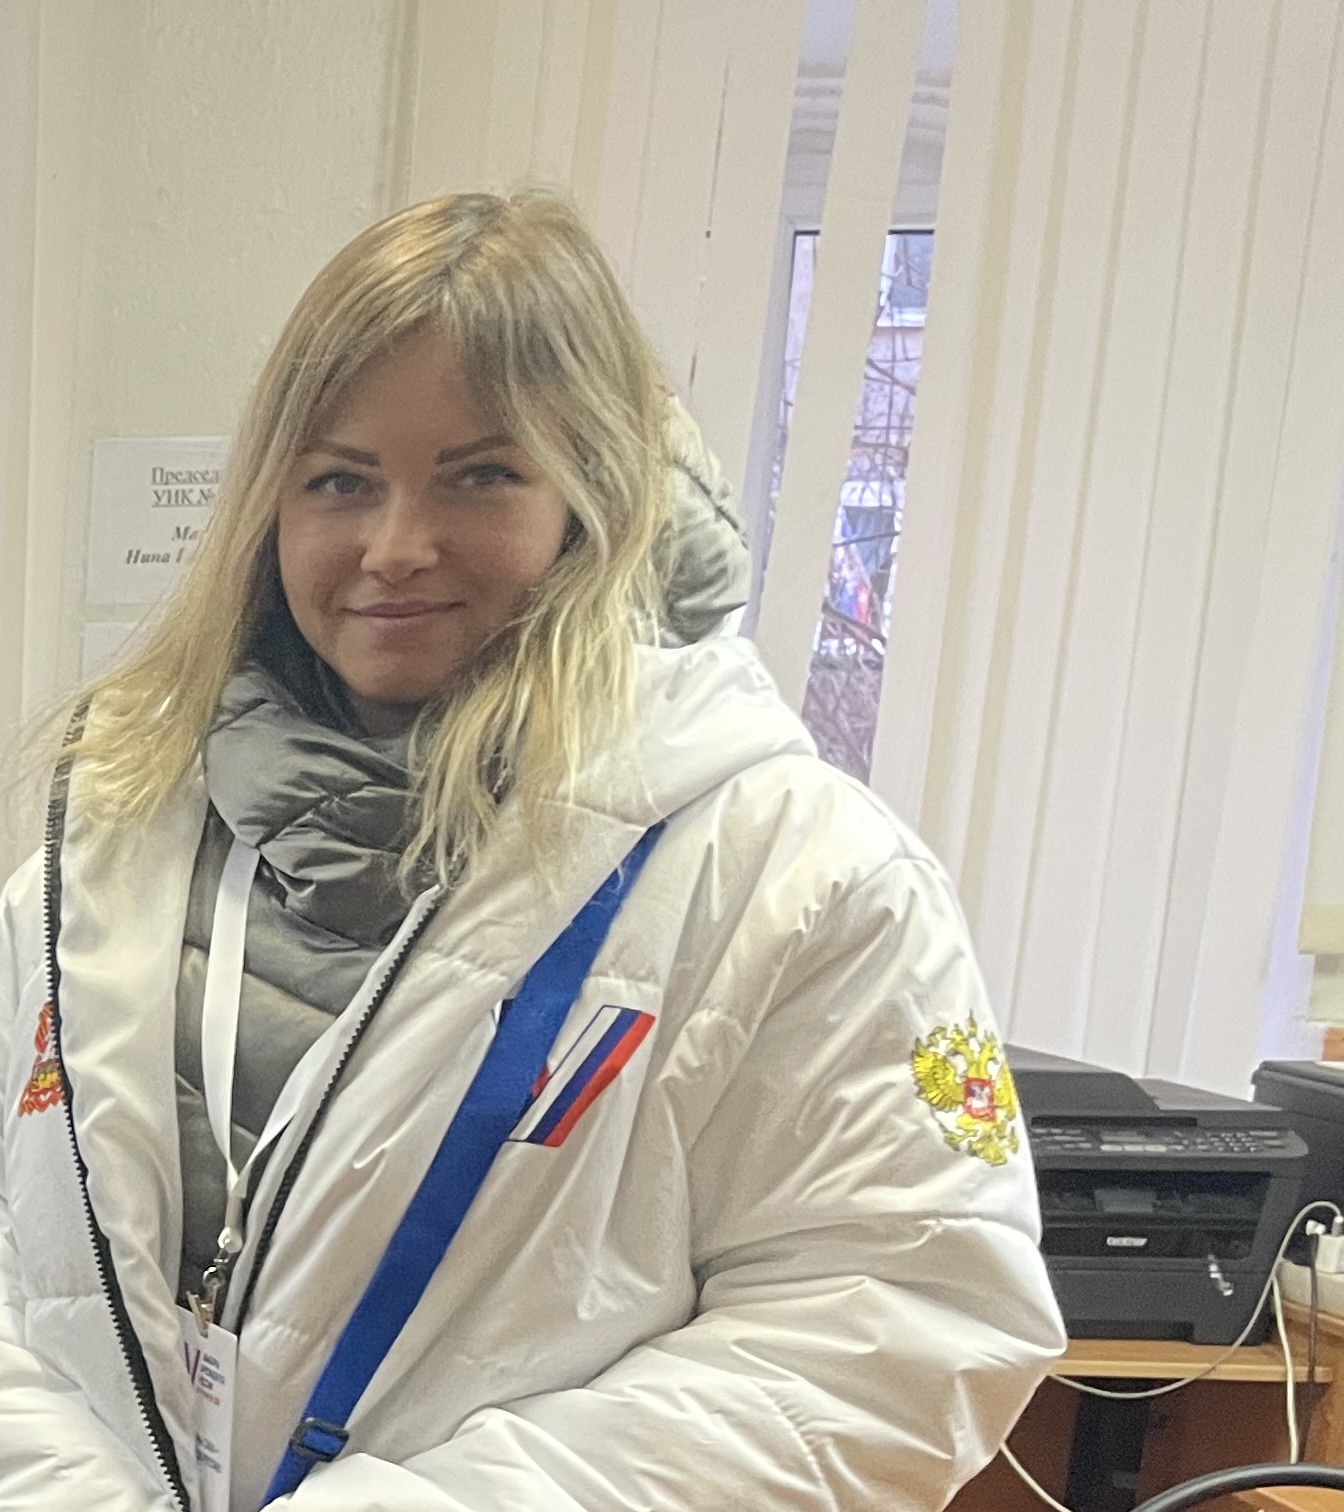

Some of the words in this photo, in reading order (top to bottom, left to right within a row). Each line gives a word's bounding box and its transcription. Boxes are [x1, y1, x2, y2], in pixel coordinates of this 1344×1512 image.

[152, 467, 219, 485] Председ
[152, 489, 193, 505] УИК
[126, 549, 171, 565] Нина
